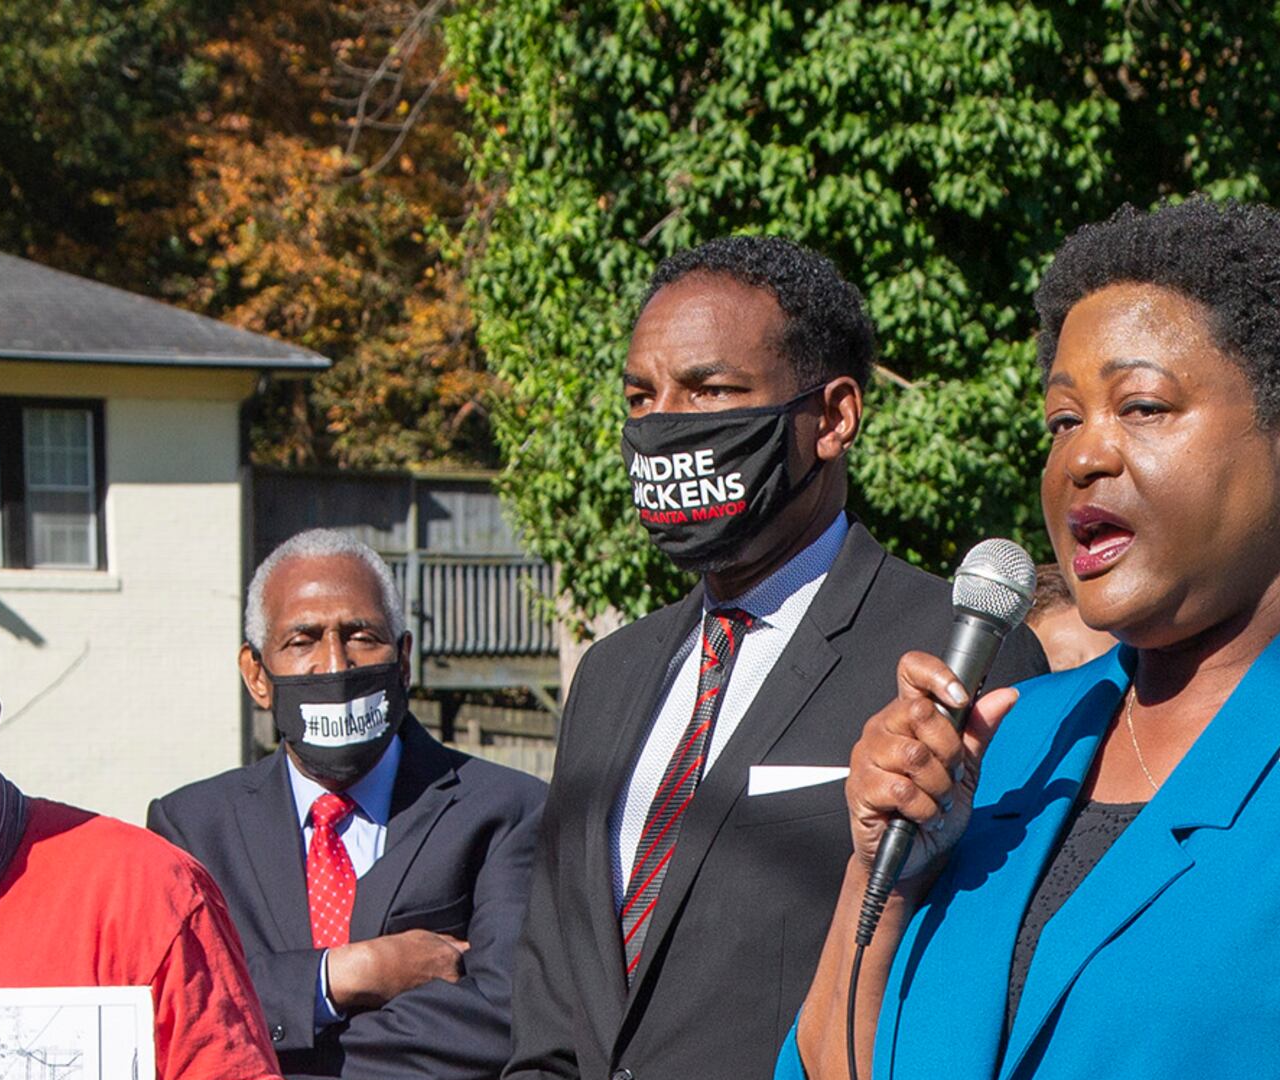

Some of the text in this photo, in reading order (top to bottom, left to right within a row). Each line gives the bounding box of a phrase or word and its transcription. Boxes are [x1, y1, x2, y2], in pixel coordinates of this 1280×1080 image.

[630, 449, 714, 481] ANDRE
[692, 502, 746, 521] MAYOR
[309, 707, 382, 737] #DoItAgain
